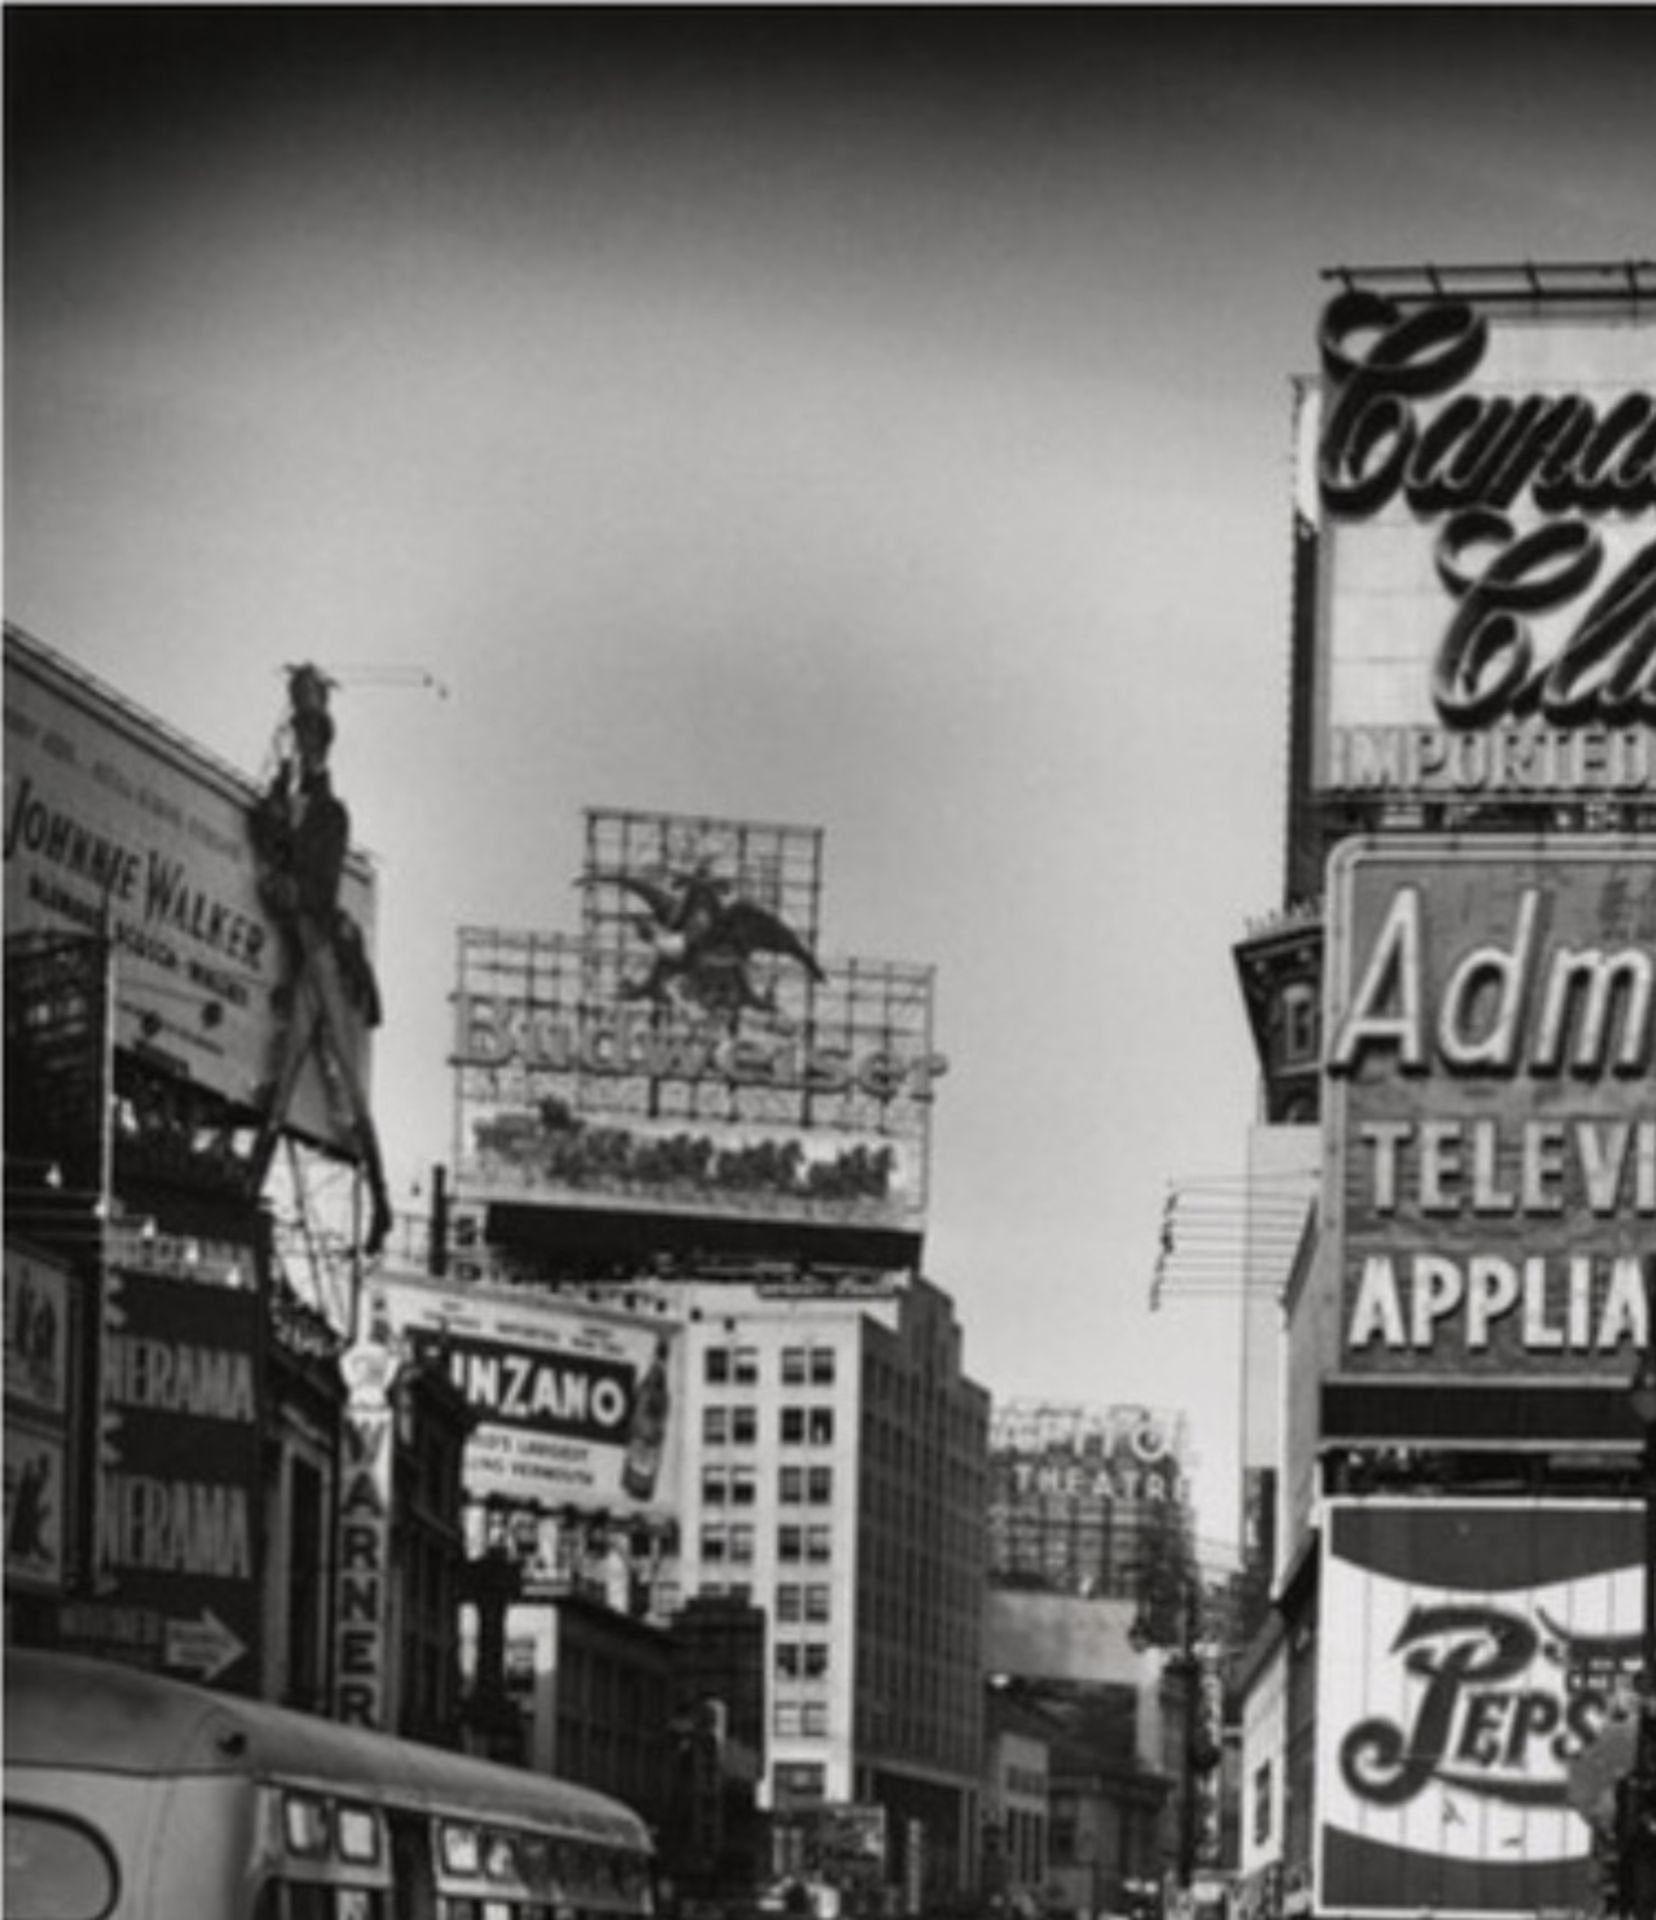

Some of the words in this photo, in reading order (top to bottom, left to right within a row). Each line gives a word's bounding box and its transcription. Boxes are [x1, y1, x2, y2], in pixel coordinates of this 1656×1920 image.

[1330, 727, 1654, 794] IMPORTED
[4, 777, 141, 899] JOHNNIE
[145, 849, 265, 972] WALKER
[450, 995, 948, 1102] Budweiser
[1331, 887, 1654, 1073] Adm
[1347, 1255, 1649, 1351] APPLIA
[342, 1416, 388, 1728] WARNER
